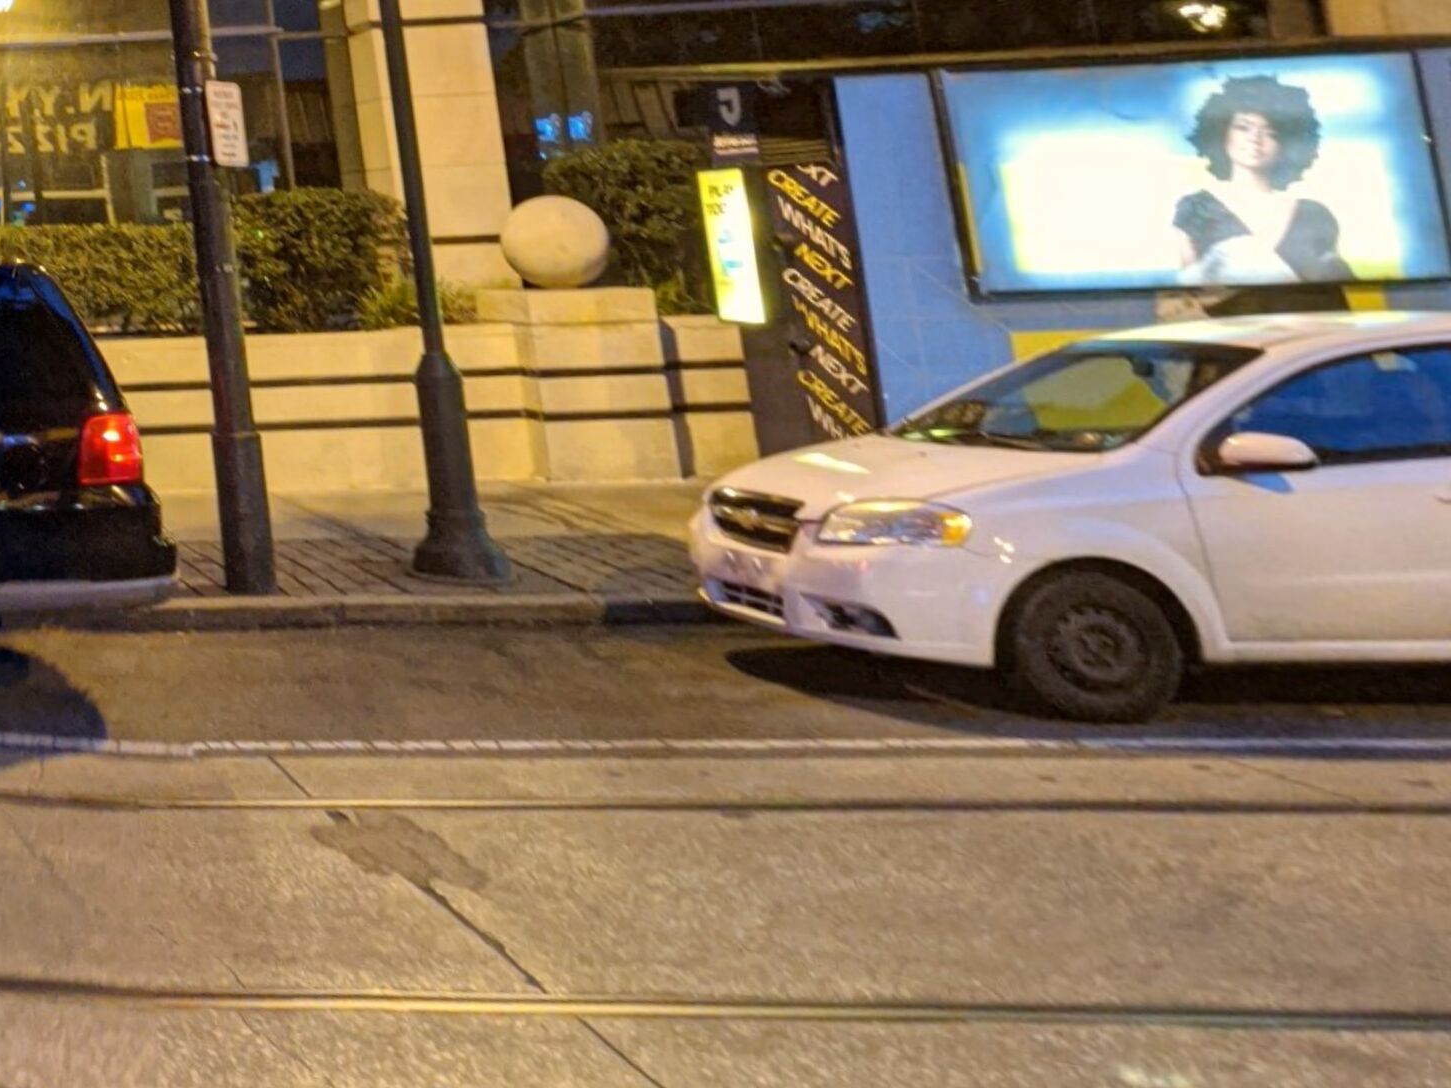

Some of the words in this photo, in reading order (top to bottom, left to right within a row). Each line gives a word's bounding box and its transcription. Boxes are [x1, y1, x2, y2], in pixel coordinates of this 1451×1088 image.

[767, 169, 842, 229] CREATE
[776, 194, 853, 271] WHAT'S
[794, 243, 855, 290] NEXT
[782, 268, 857, 333] CREATE
[809, 344, 870, 394] NEXT
[797, 369, 872, 437] CREATE
